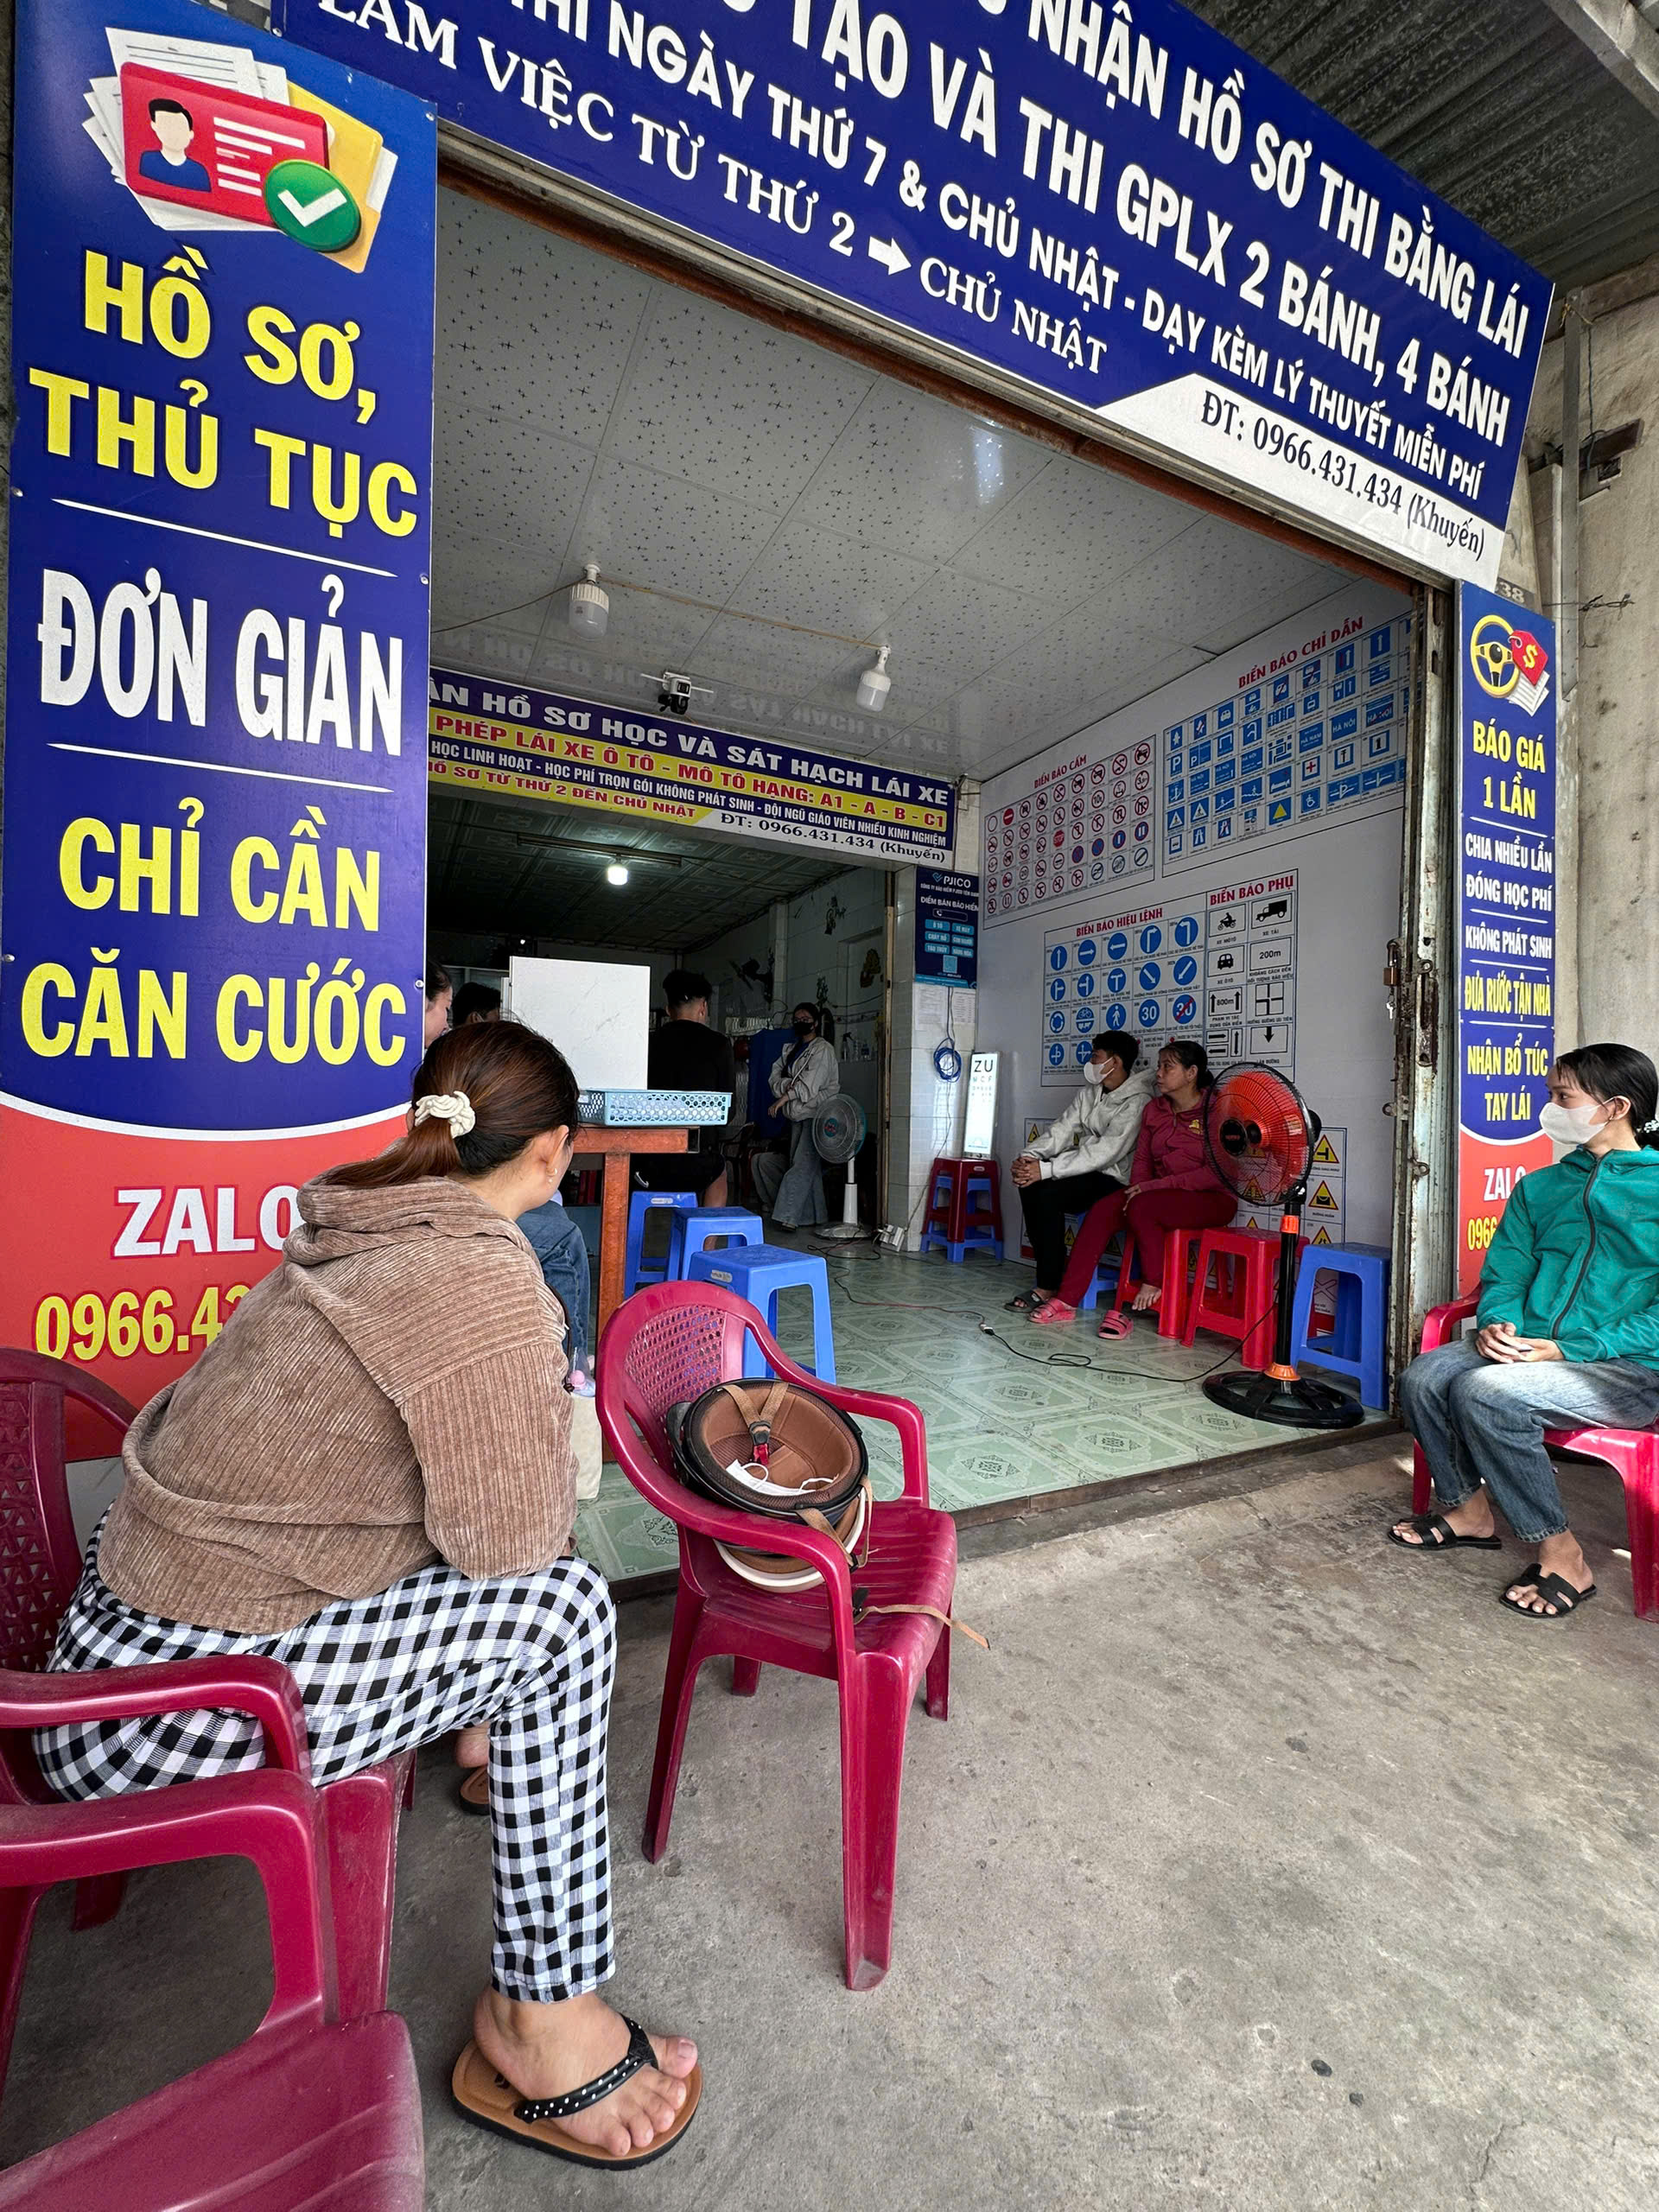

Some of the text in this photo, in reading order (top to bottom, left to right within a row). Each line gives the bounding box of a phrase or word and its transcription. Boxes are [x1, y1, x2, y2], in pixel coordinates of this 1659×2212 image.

[478, 37, 613, 141] VIỆC
[632, 114, 704, 180] TỪ
[718, 154, 818, 233] THỨ
[830, 212, 855, 256] 2
[921, 258, 1001, 322] CHỦ
[1012, 299, 1107, 374] NHẬT
[1029, 0, 1529, 359] NHẬN HỒ SƠ THI BẰNG LÁI
[512, 0, 1485, 500] HI NGÀY THỨ 7 & CHỦ NHẬT DẠY KÈM LÝ THUYẾT MIỄN PHÍ
[931, 43, 995, 157] VÀ
[1020, 98, 1103, 213] THI
[1117, 164, 1232, 286] GPLX
[1241, 242, 1268, 308] 2
[1279, 261, 1384, 387] BÁNH,
[1397, 339, 1419, 394] 4
[1427, 353, 1510, 447] BÁNH
[86, 245, 377, 424] HỒ SƠ,
[29, 368, 417, 538] THỦ TỤC
[1201, 391, 1484, 562] ĐT: 0966.431.434 (Khuyến)
[38, 568, 403, 756] ĐƠN GIẢN
[1270, 650, 1298, 673] BÁO
[1302, 631, 1326, 656] CHỈ
[1332, 616, 1363, 643] DẪN
[435, 716, 944, 827] PHÉP LÁI XE Ô TÔ MÔ TÔ HẠNG: A1 A B C1
[483, 695, 531, 718] HỒ
[544, 707, 591, 730] SƠ
[602, 718, 666, 746] HỌC
[678, 734, 716, 758] VÀ
[728, 747, 782, 771] SÁT
[791, 759, 862, 788] HẠCH
[872, 776, 909, 798] LÁI
[918, 786, 949, 805] XE
[1472, 718, 1545, 773] BÁO GIÁ
[432, 741, 459, 758] HỌC
[464, 747, 494, 764] LINH
[499, 753, 532, 772] HOẠT
[545, 762, 571, 779] HỌC
[575, 767, 594, 782] PHÍ
[599, 772, 629, 791] TRỌN
[633, 778, 653, 793] GÓI
[657, 783, 695, 801] KHÔNG
[698, 790, 726, 807] PHÁT
[729, 798, 754, 811] SINH
[765, 803, 782, 818] ĐỘI
[809, 810, 831, 826] GIÁO
[834, 816, 855, 830] VIÊN
[888, 827, 910, 841] KINH
[454, 766, 480, 779] SƠ
[516, 776, 552, 792] THỨ
[556, 785, 567, 796] 2
[613, 794, 648, 810] CHỦ
[652, 802, 696, 819] NHẬT
[1483, 772, 1535, 819] 1 LẦN
[60, 798, 380, 931] CHỈ CẦN
[759, 819, 874, 849] 0966.431.434
[880, 841, 946, 863] (Khuyến)
[1465, 832, 1492, 861] CHIA
[944, 875, 971, 888] PJICO
[1239, 881, 1264, 899] BÁO
[1268, 875, 1294, 893] PHỤ
[1465, 870, 1553, 912] ĐÓNG HỌC PHÍ
[1259, 950, 1281, 959] 200m
[1465, 921, 1553, 959] KHÔNG PHÁT SINH
[22, 948, 407, 1066] CĂN CƯỚC
[1141, 1006, 1156, 1020] 30
[1465, 969, 1551, 1022] ĐƯA RƯỚC TẬN NHÀ
[1467, 1033, 1548, 1081] NHẬN BỔ TÚC
[1484, 1084, 1531, 1121] TAY LÁI
[113, 1187, 300, 1256] ZALO
